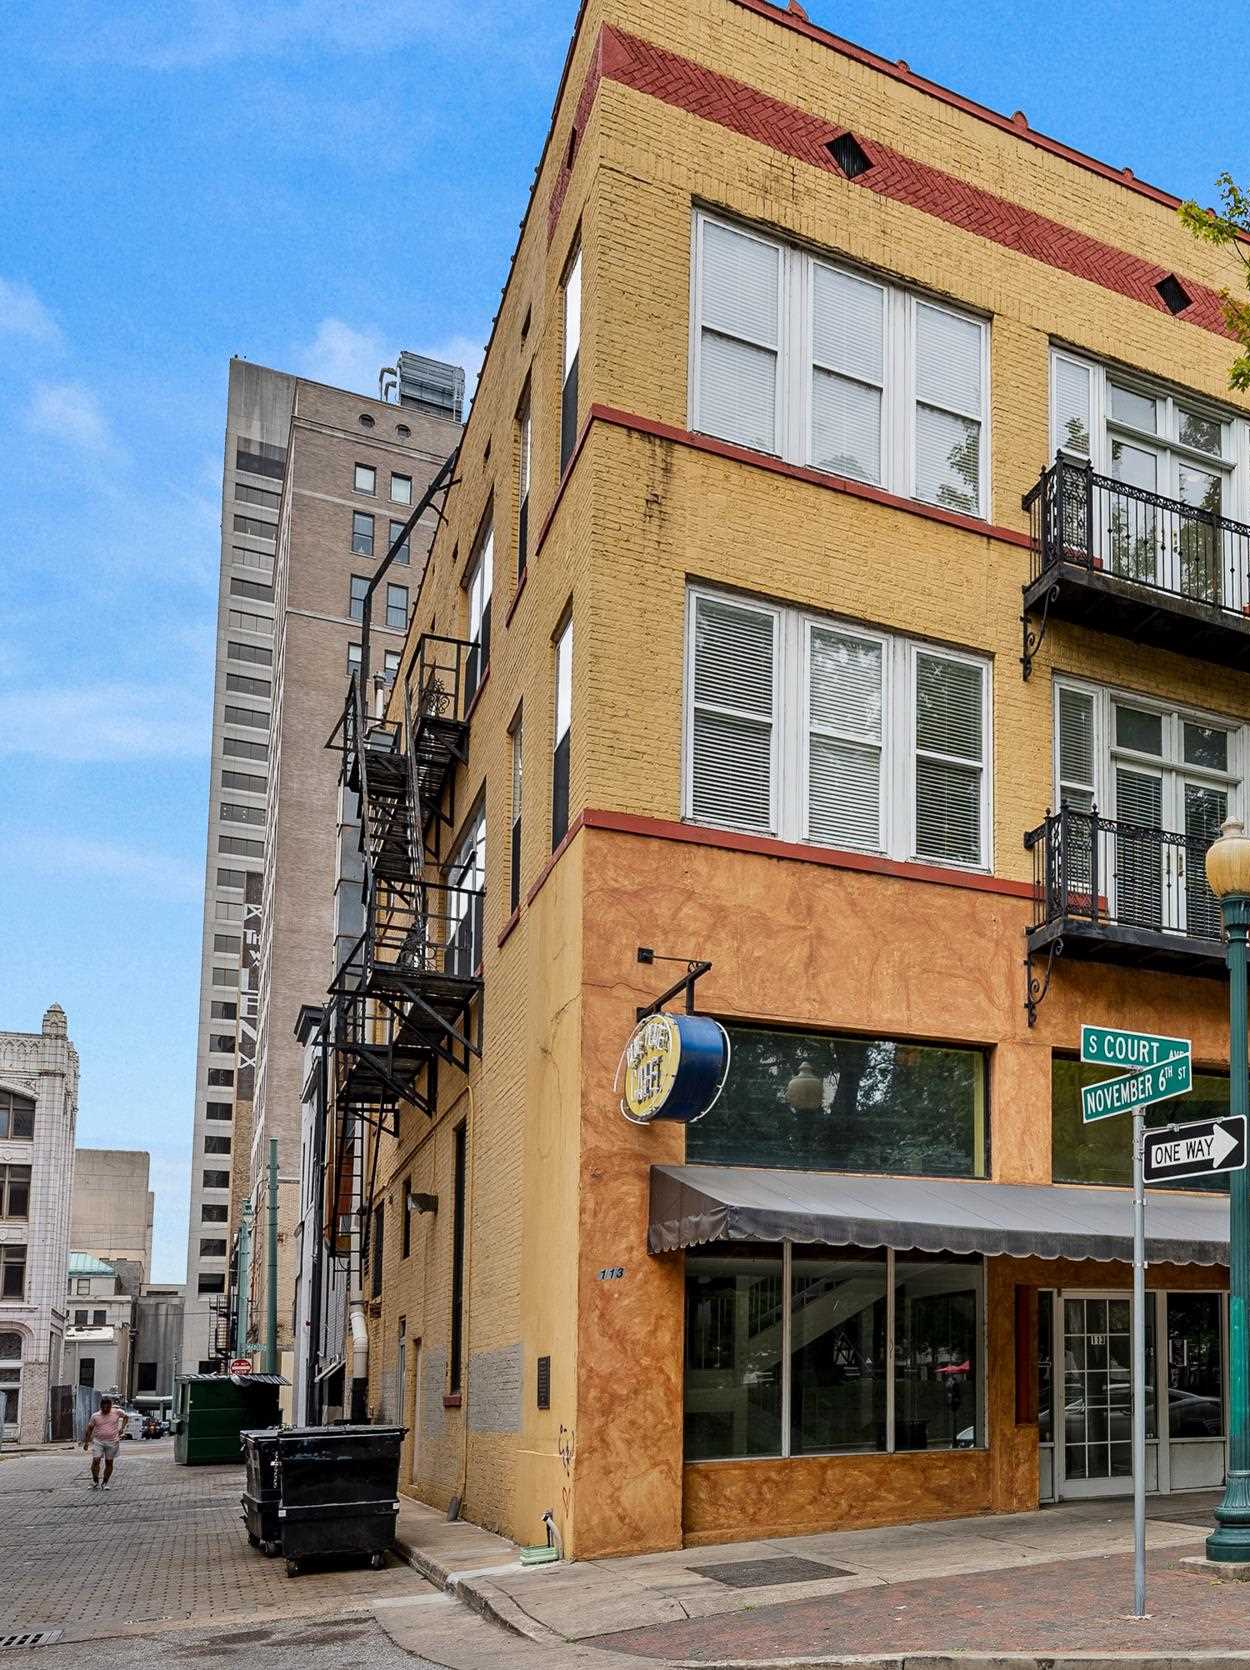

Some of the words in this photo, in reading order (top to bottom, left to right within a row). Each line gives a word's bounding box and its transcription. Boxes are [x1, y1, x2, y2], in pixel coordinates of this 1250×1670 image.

[1089, 1035, 1097, 1053] S
[1104, 1036, 1160, 1064] COURT
[1087, 1074, 1153, 1114] NOVEMBER
[1158, 1067, 1173, 1092] 6TH
[1178, 1066, 1187, 1080] ST
[1155, 1143, 1180, 1164] ONE
[1186, 1138, 1213, 1159] WAY
[601, 1267, 624, 1279] 113
